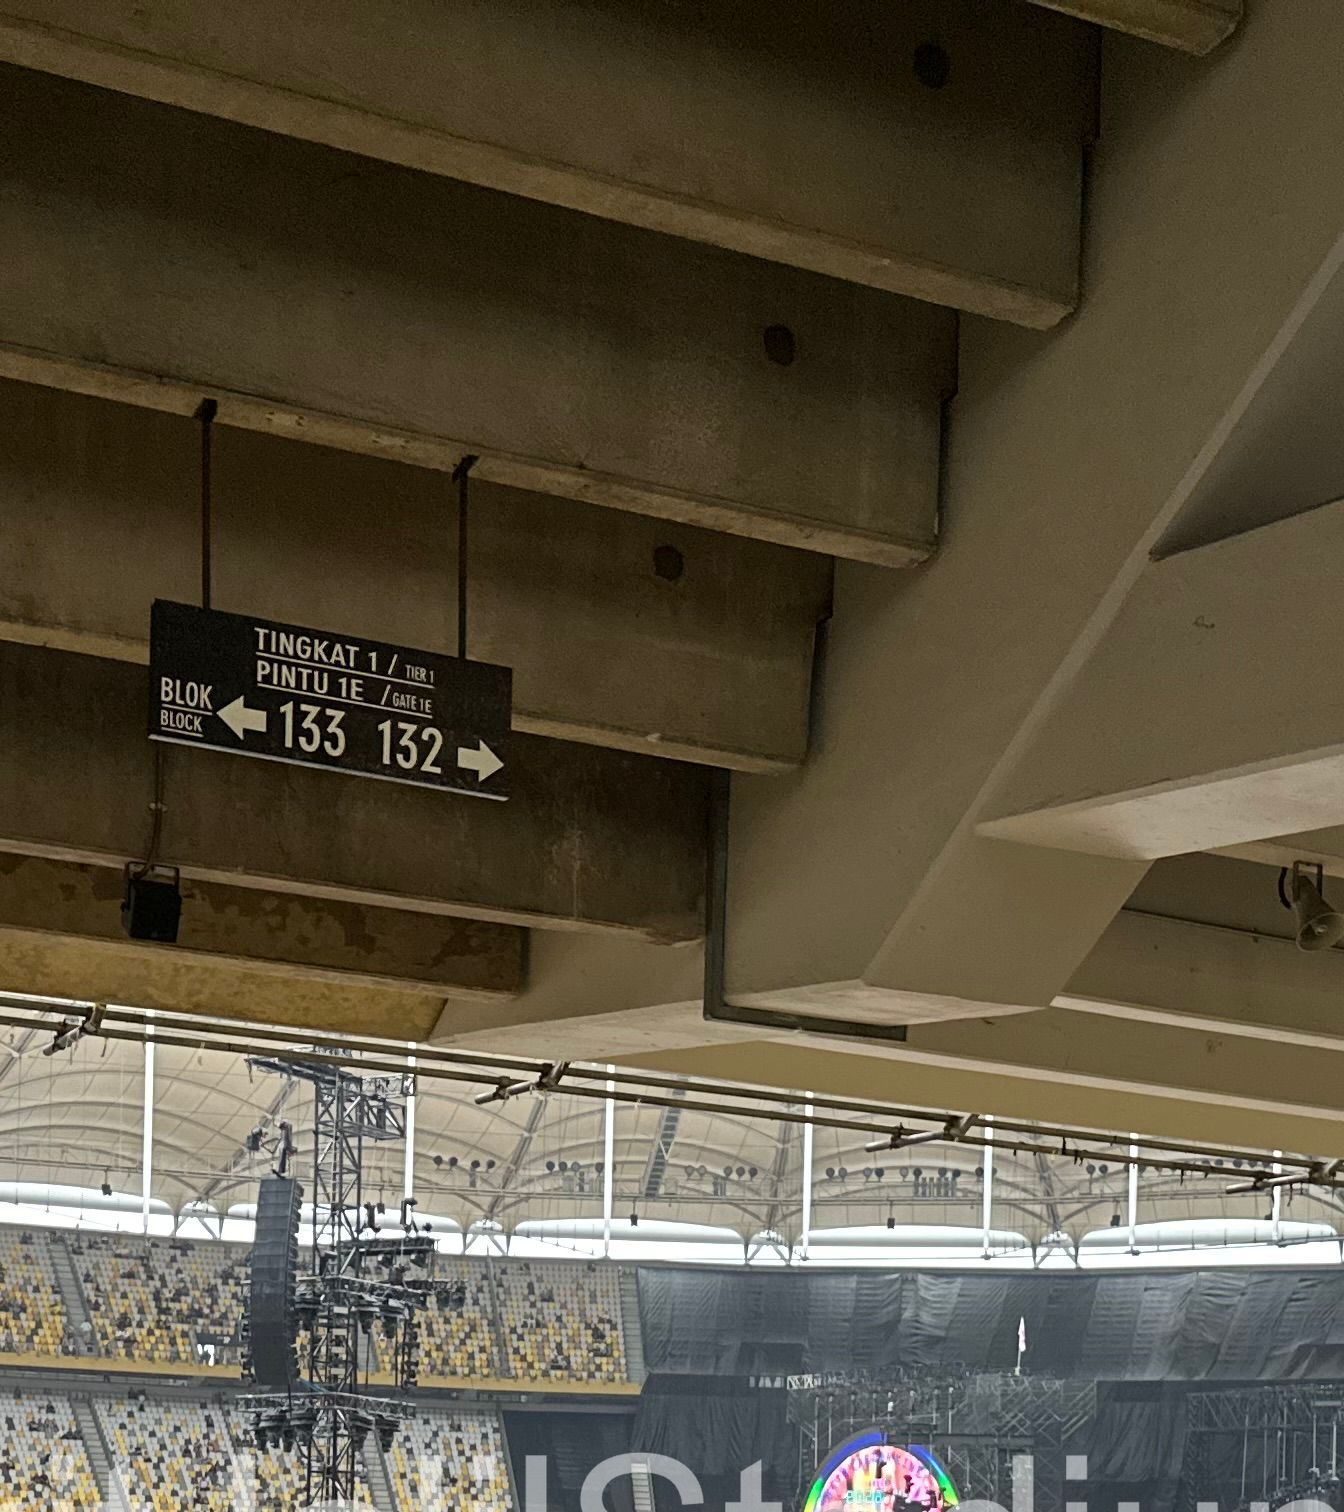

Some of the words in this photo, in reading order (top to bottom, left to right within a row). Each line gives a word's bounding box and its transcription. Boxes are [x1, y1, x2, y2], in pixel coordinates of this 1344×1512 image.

[254, 626, 360, 670] TINGKAT
[367, 651, 378, 674] 1
[404, 663, 427, 681] TIER
[428, 669, 435, 684] 1
[159, 676, 214, 711] BLOK
[256, 659, 330, 695] PINTU
[337, 676, 364, 701] 1E
[419, 697, 433, 714] 1E
[159, 708, 204, 733] BLOCK
[278, 700, 347, 758] 133
[376, 718, 444, 775] 132
